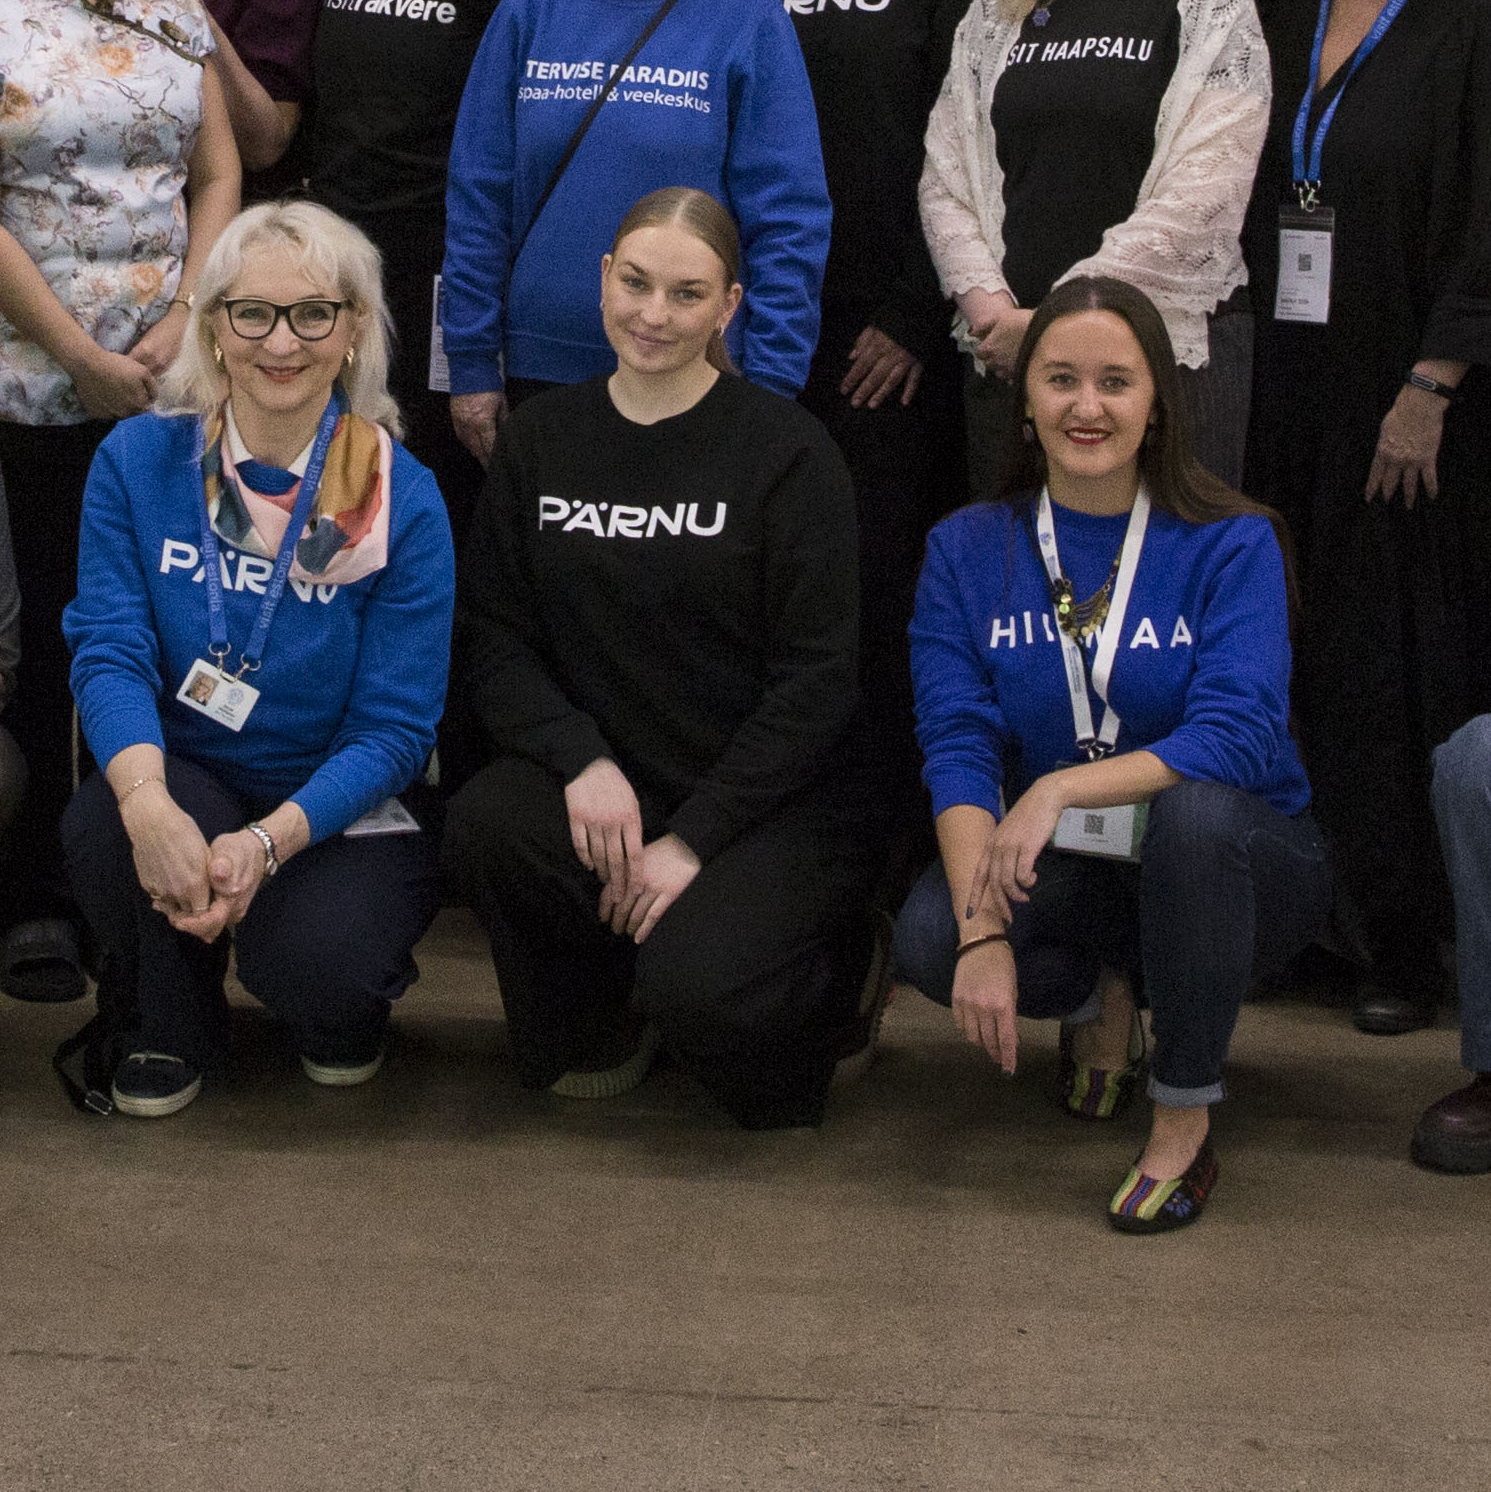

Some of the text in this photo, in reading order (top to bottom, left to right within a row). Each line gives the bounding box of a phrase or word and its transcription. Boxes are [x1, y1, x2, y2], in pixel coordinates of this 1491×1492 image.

[1007, 36, 1154, 66] SIT HAAPSALU
[526, 59, 605, 81] TERVISE
[606, 87, 618, 101] &
[623, 88, 711, 114] veekeskus
[539, 496, 727, 539] PÄRNU
